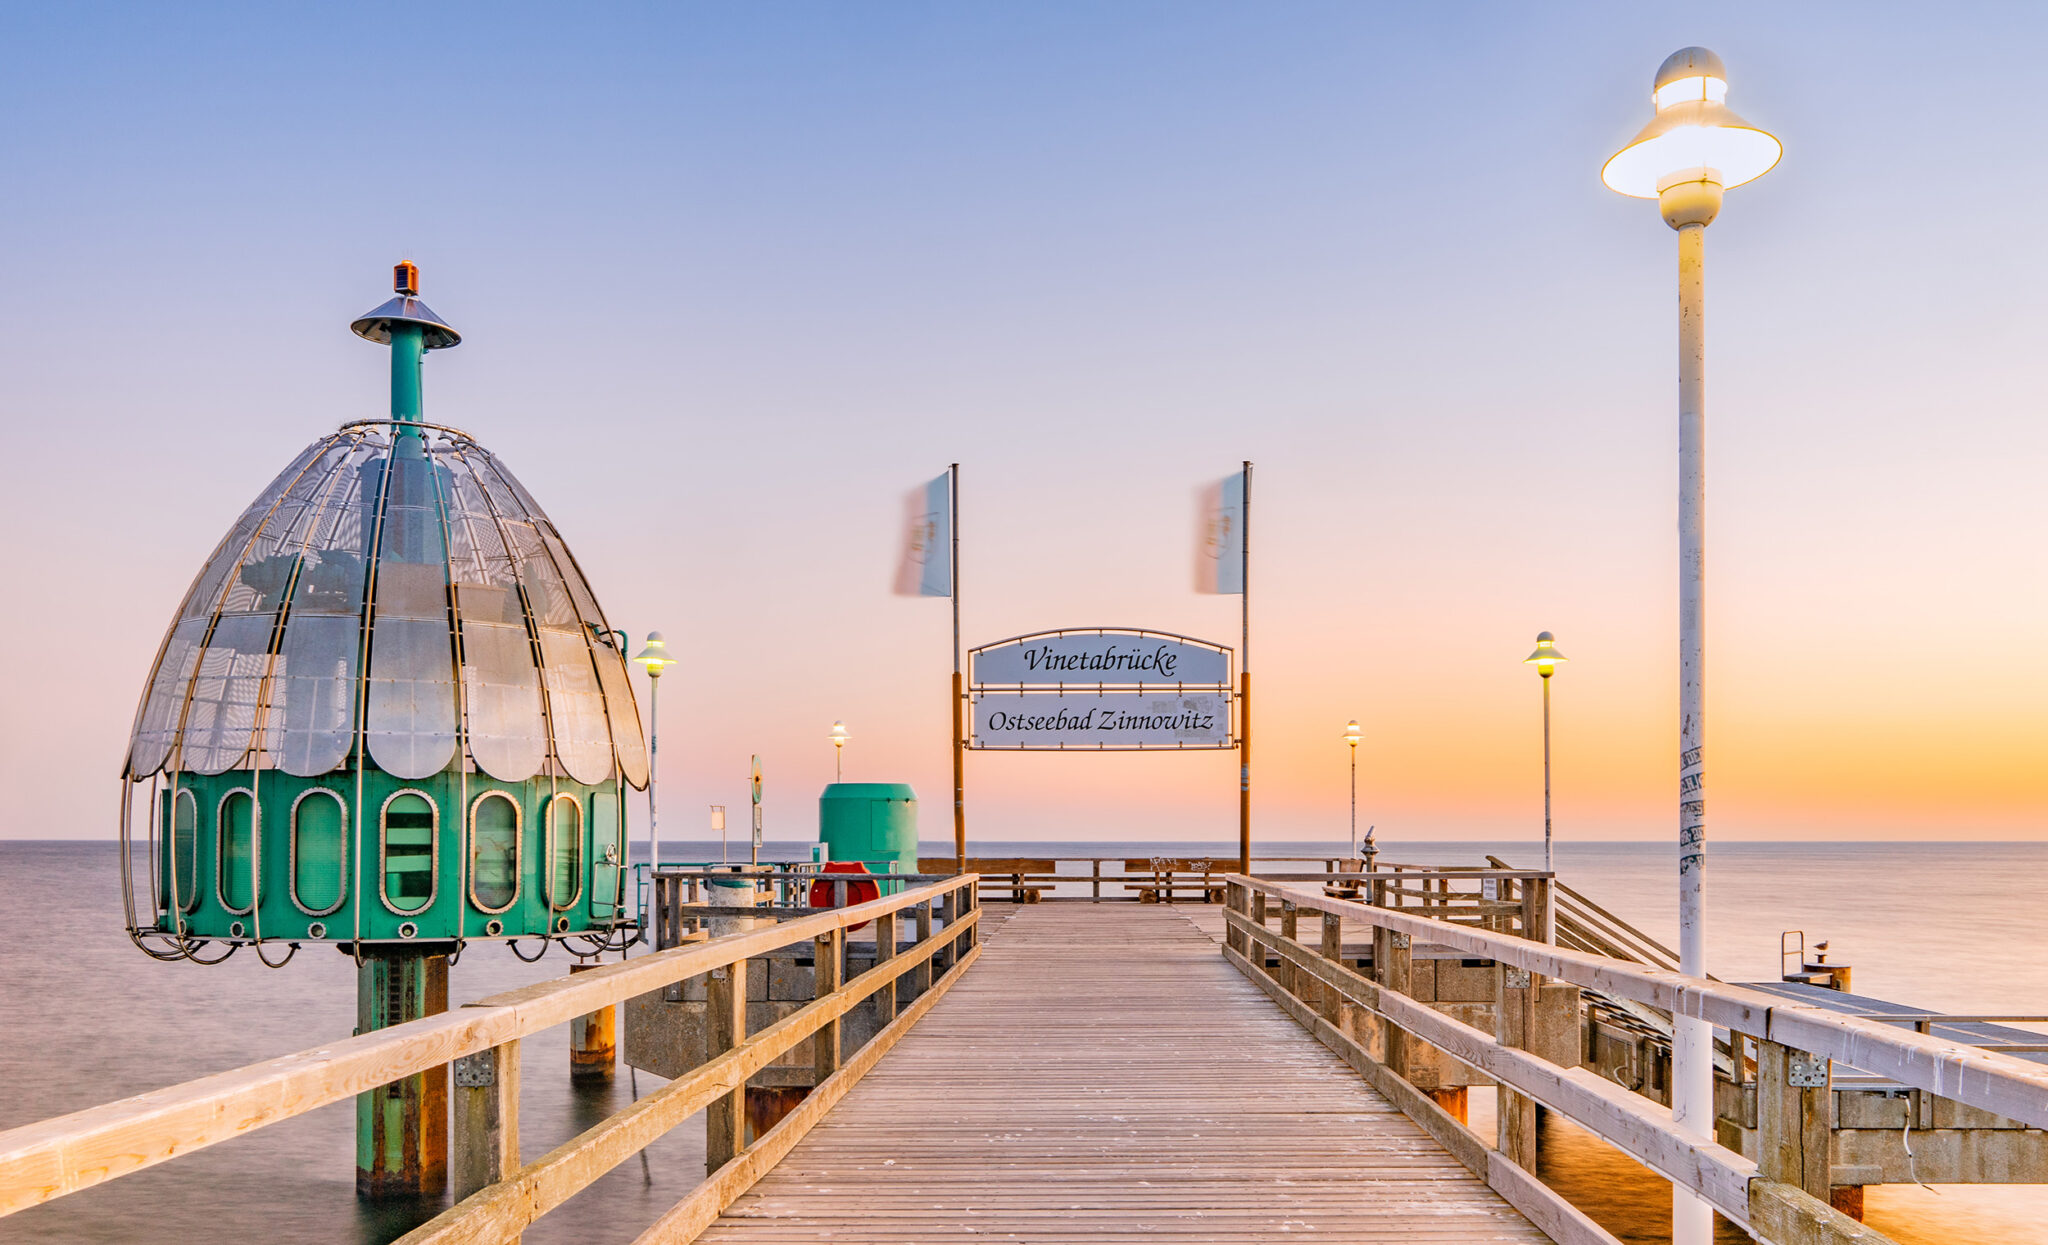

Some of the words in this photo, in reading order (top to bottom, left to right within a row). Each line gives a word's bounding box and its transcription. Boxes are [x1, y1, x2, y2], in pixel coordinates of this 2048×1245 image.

[1024, 645, 1178, 677] Vinetabrücke
[989, 708, 1096, 731] Ostseebad
[1097, 710, 1213, 730] Zinnowitz
